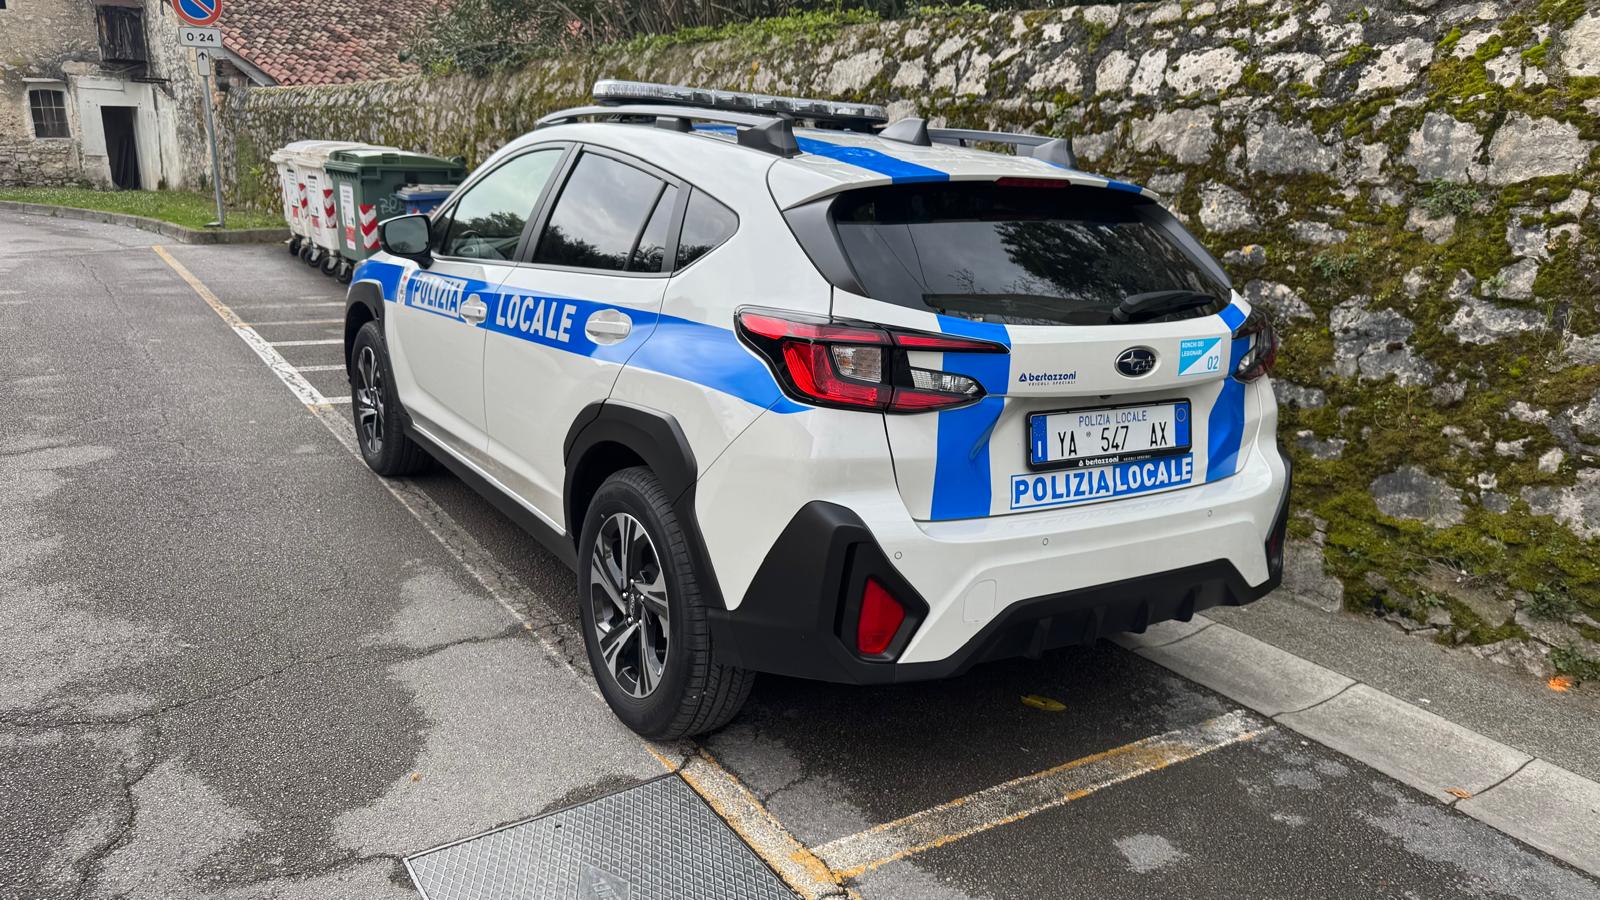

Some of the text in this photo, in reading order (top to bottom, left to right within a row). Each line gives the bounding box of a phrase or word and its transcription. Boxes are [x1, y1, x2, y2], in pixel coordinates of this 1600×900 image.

[413, 277, 461, 314] POLIZIA
[496, 292, 577, 343] LOCALE
[1207, 355, 1219, 370] 02
[1028, 371, 1077, 382] bertazzoni
[1078, 410, 1148, 428] POLIZIA LOCALE
[1058, 421, 1167, 457] YA 547 AX
[1014, 457, 1192, 505] POLIZIA LOCALE
